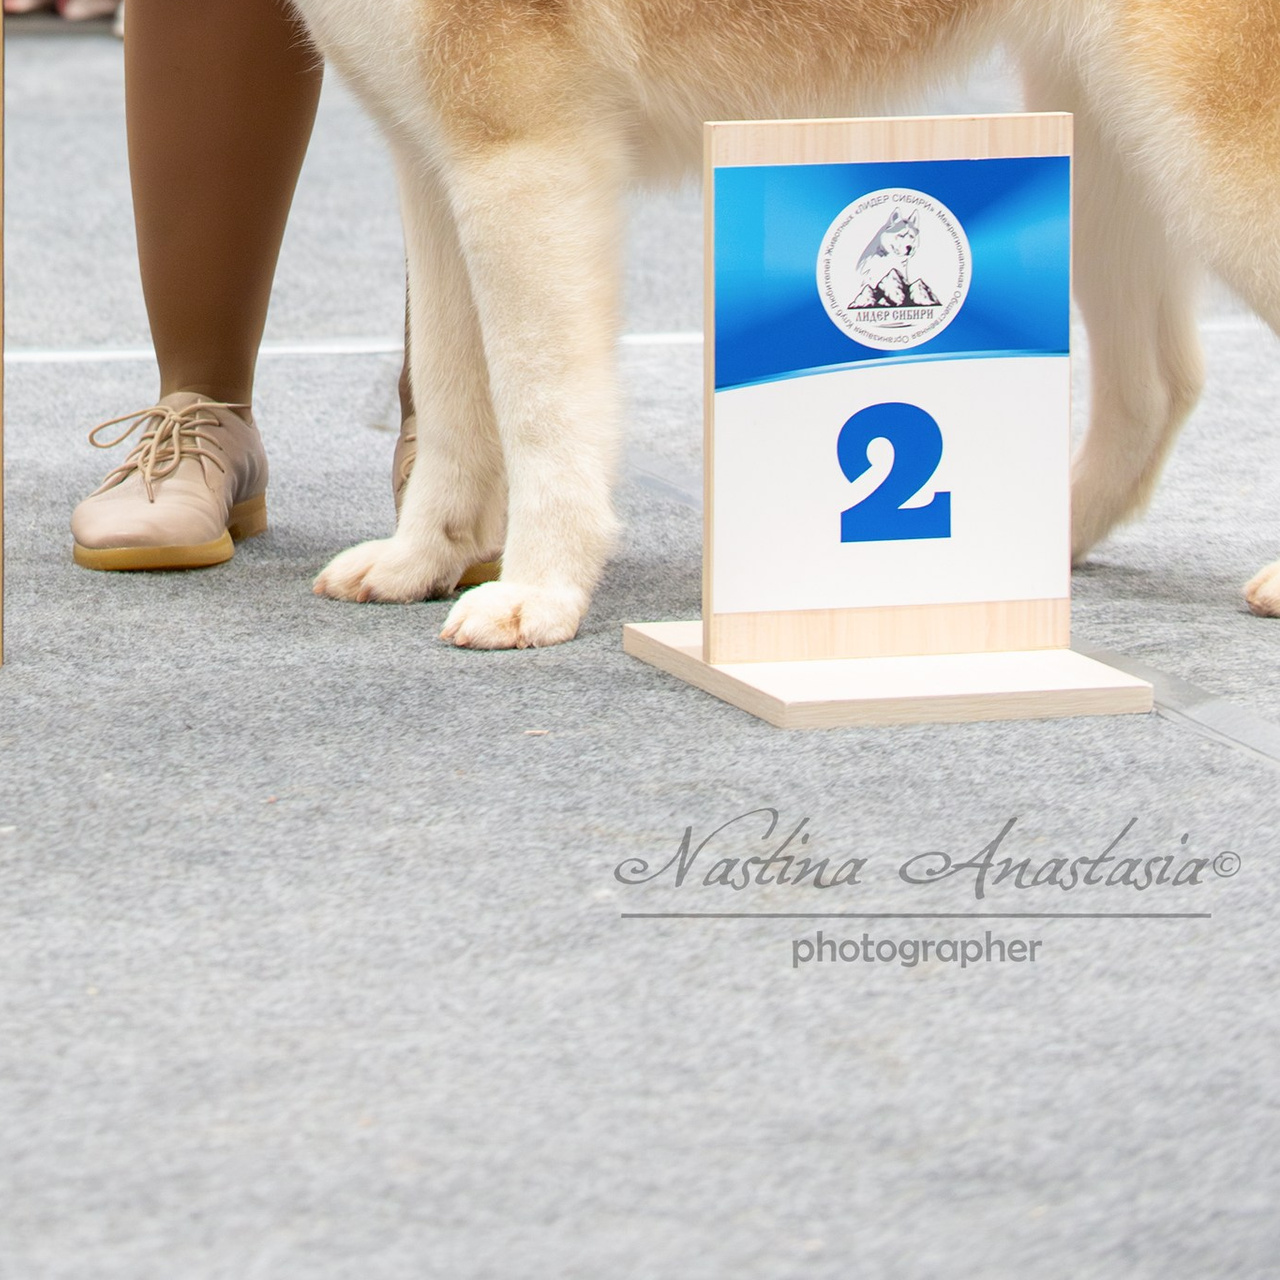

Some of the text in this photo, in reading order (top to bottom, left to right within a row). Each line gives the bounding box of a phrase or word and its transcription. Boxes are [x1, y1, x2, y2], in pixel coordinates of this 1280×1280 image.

[855, 308, 934, 323] ЛИДЕР СИБИРИ
[836, 402, 952, 543] 2
